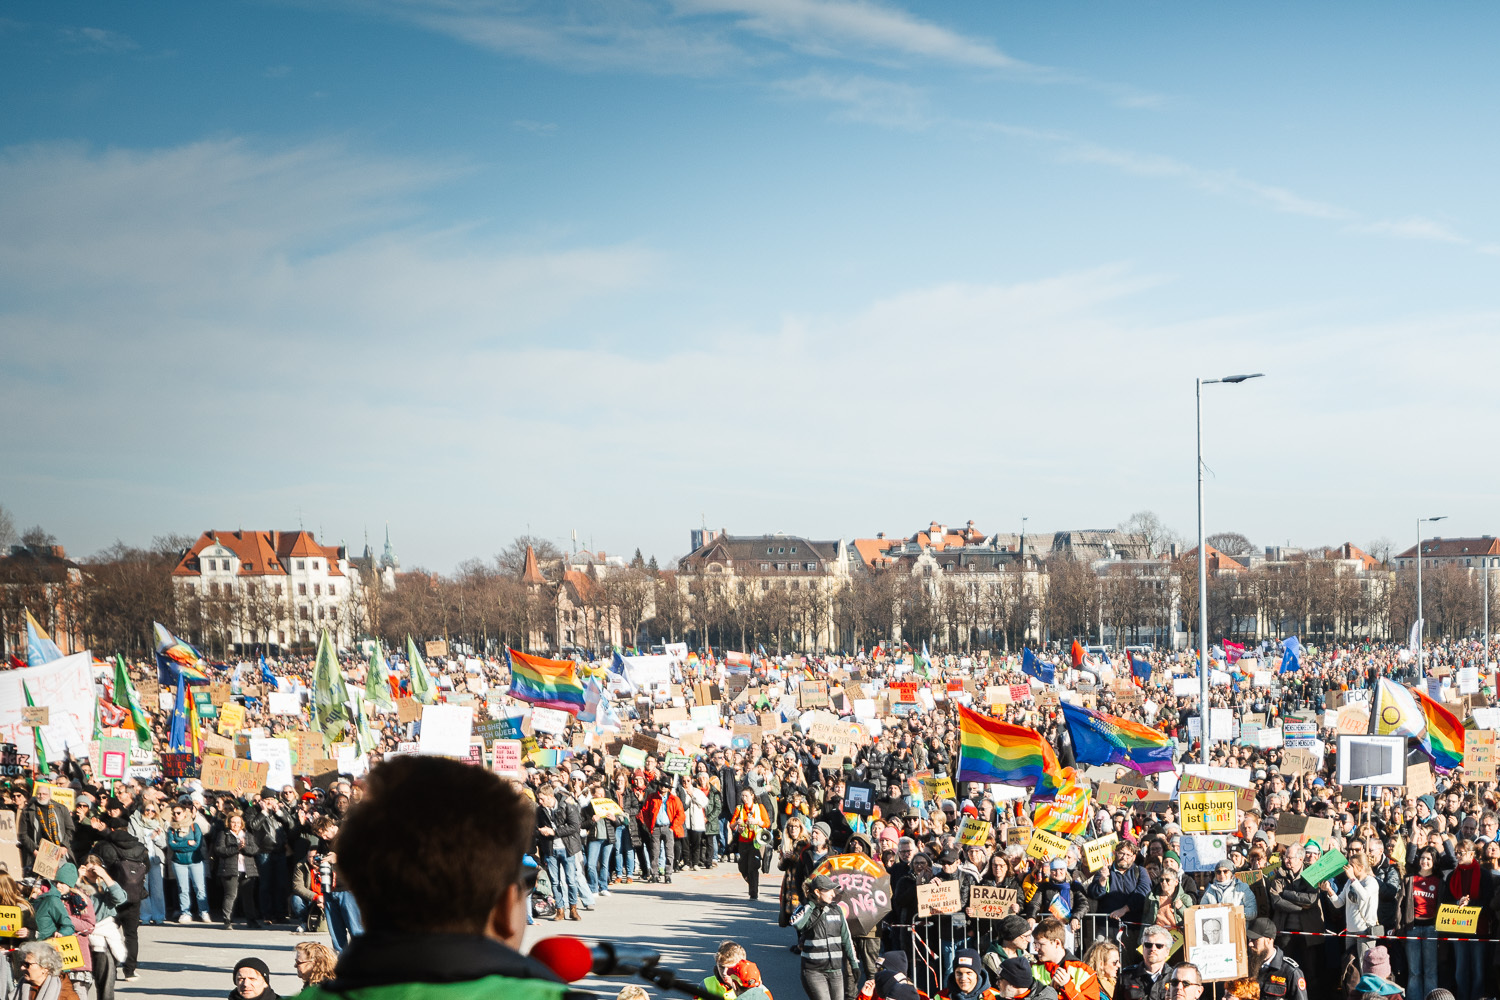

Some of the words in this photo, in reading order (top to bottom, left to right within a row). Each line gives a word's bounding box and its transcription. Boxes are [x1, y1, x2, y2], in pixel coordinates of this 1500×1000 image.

[1346, 690, 1368, 703] FCK
[494, 727, 518, 737] QUEER
[1465, 732, 1479, 745] So
[1479, 731, 1495, 745] bad
[161, 753, 192, 762] EUROPE
[219, 759, 263, 774] VIELFALT
[1465, 769, 1477, 777] are
[1478, 767, 1493, 778] here
[1119, 786, 1134, 796] WIR
[1055, 793, 1077, 804] bunt
[1048, 799, 1088, 825] immer!
[1183, 800, 1234, 814] Augsburg
[1187, 813, 1201, 823] ist
[1203, 812, 1231, 823] bunt!
[1035, 832, 1067, 851] München
[1033, 843, 1042, 853] ist
[1091, 855, 1100, 864] ist
[973, 887, 1017, 901] BRAUN
[1441, 906, 1477, 916] München
[1440, 917, 1451, 926] ist
[1451, 917, 1473, 926] bunt!
